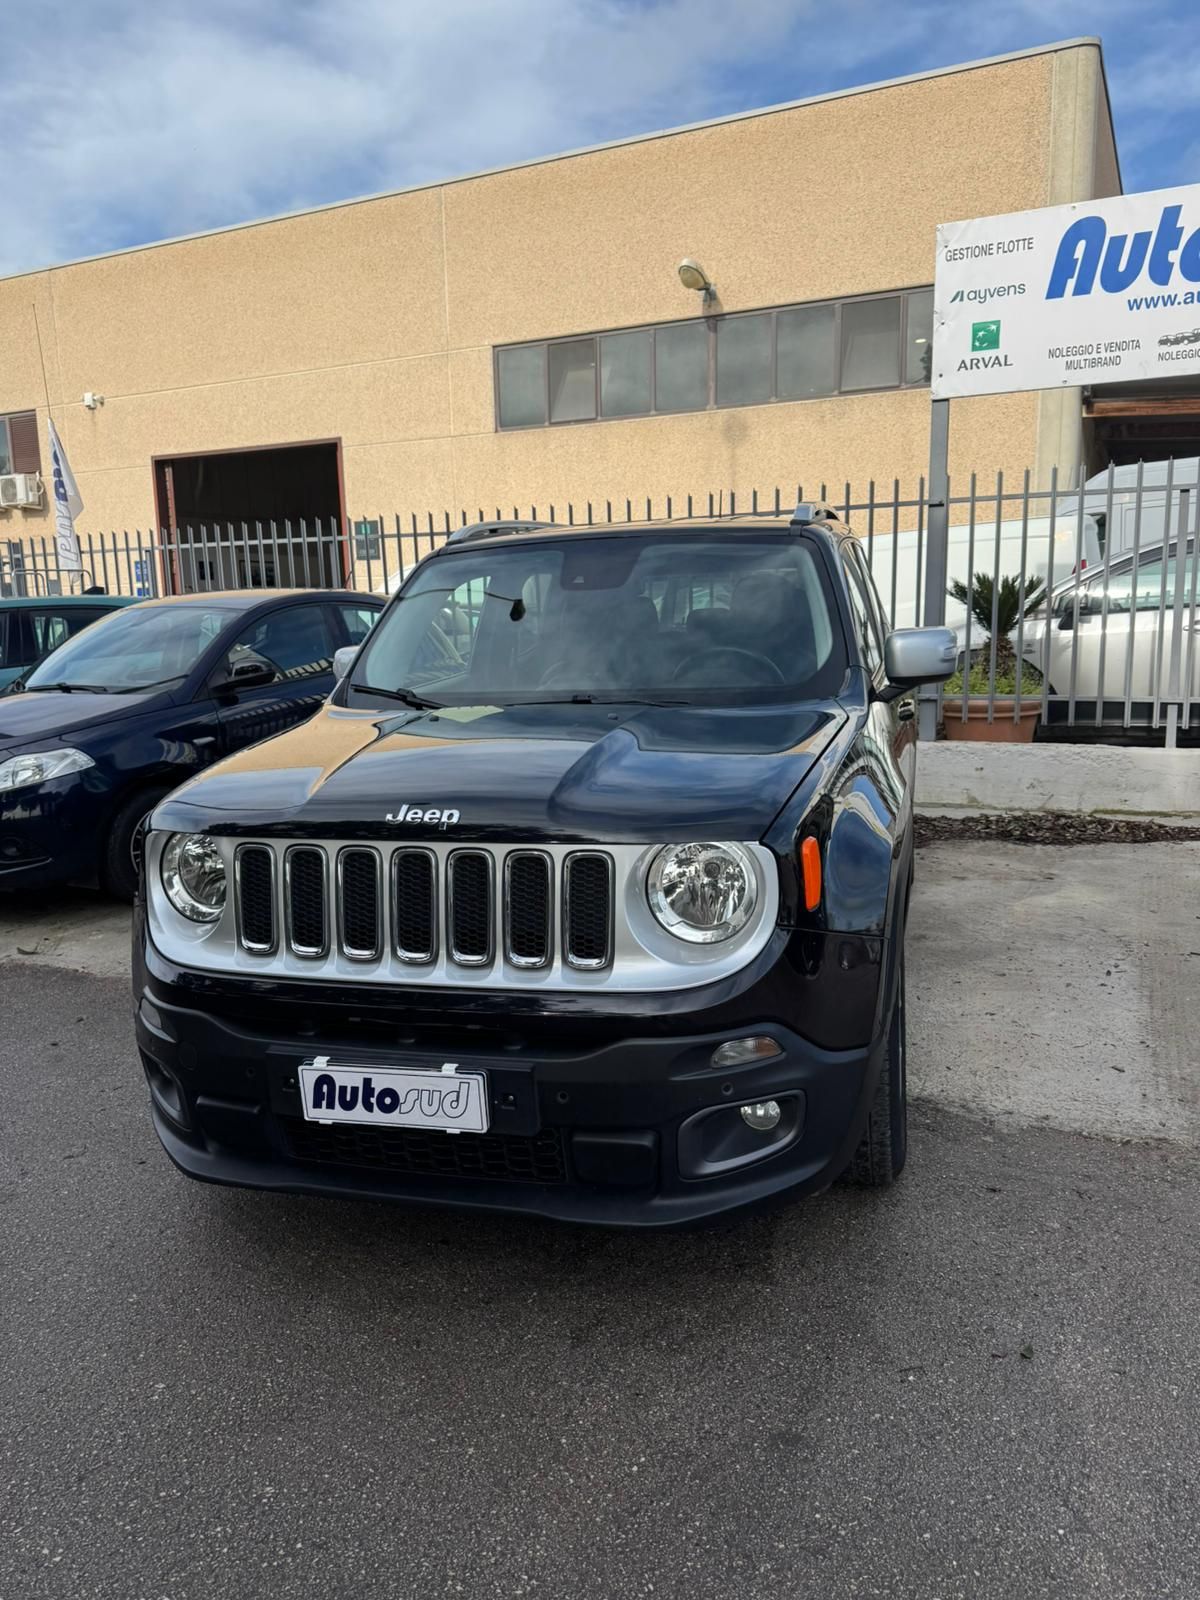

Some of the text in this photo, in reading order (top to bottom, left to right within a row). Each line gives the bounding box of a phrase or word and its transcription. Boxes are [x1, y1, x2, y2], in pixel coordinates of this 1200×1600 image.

[945, 237, 1034, 262] GESTIONE FLOTTE
[967, 283, 1026, 304] ayvens
[1127, 290, 1200, 311] www.a
[1048, 339, 1141, 359] NOLEGGIO E VENDITA
[957, 354, 1014, 372] ARVAL
[1065, 355, 1122, 371] MULTIBRAND
[385, 804, 460, 830] Jeep
[312, 1073, 470, 1119] Autosud
